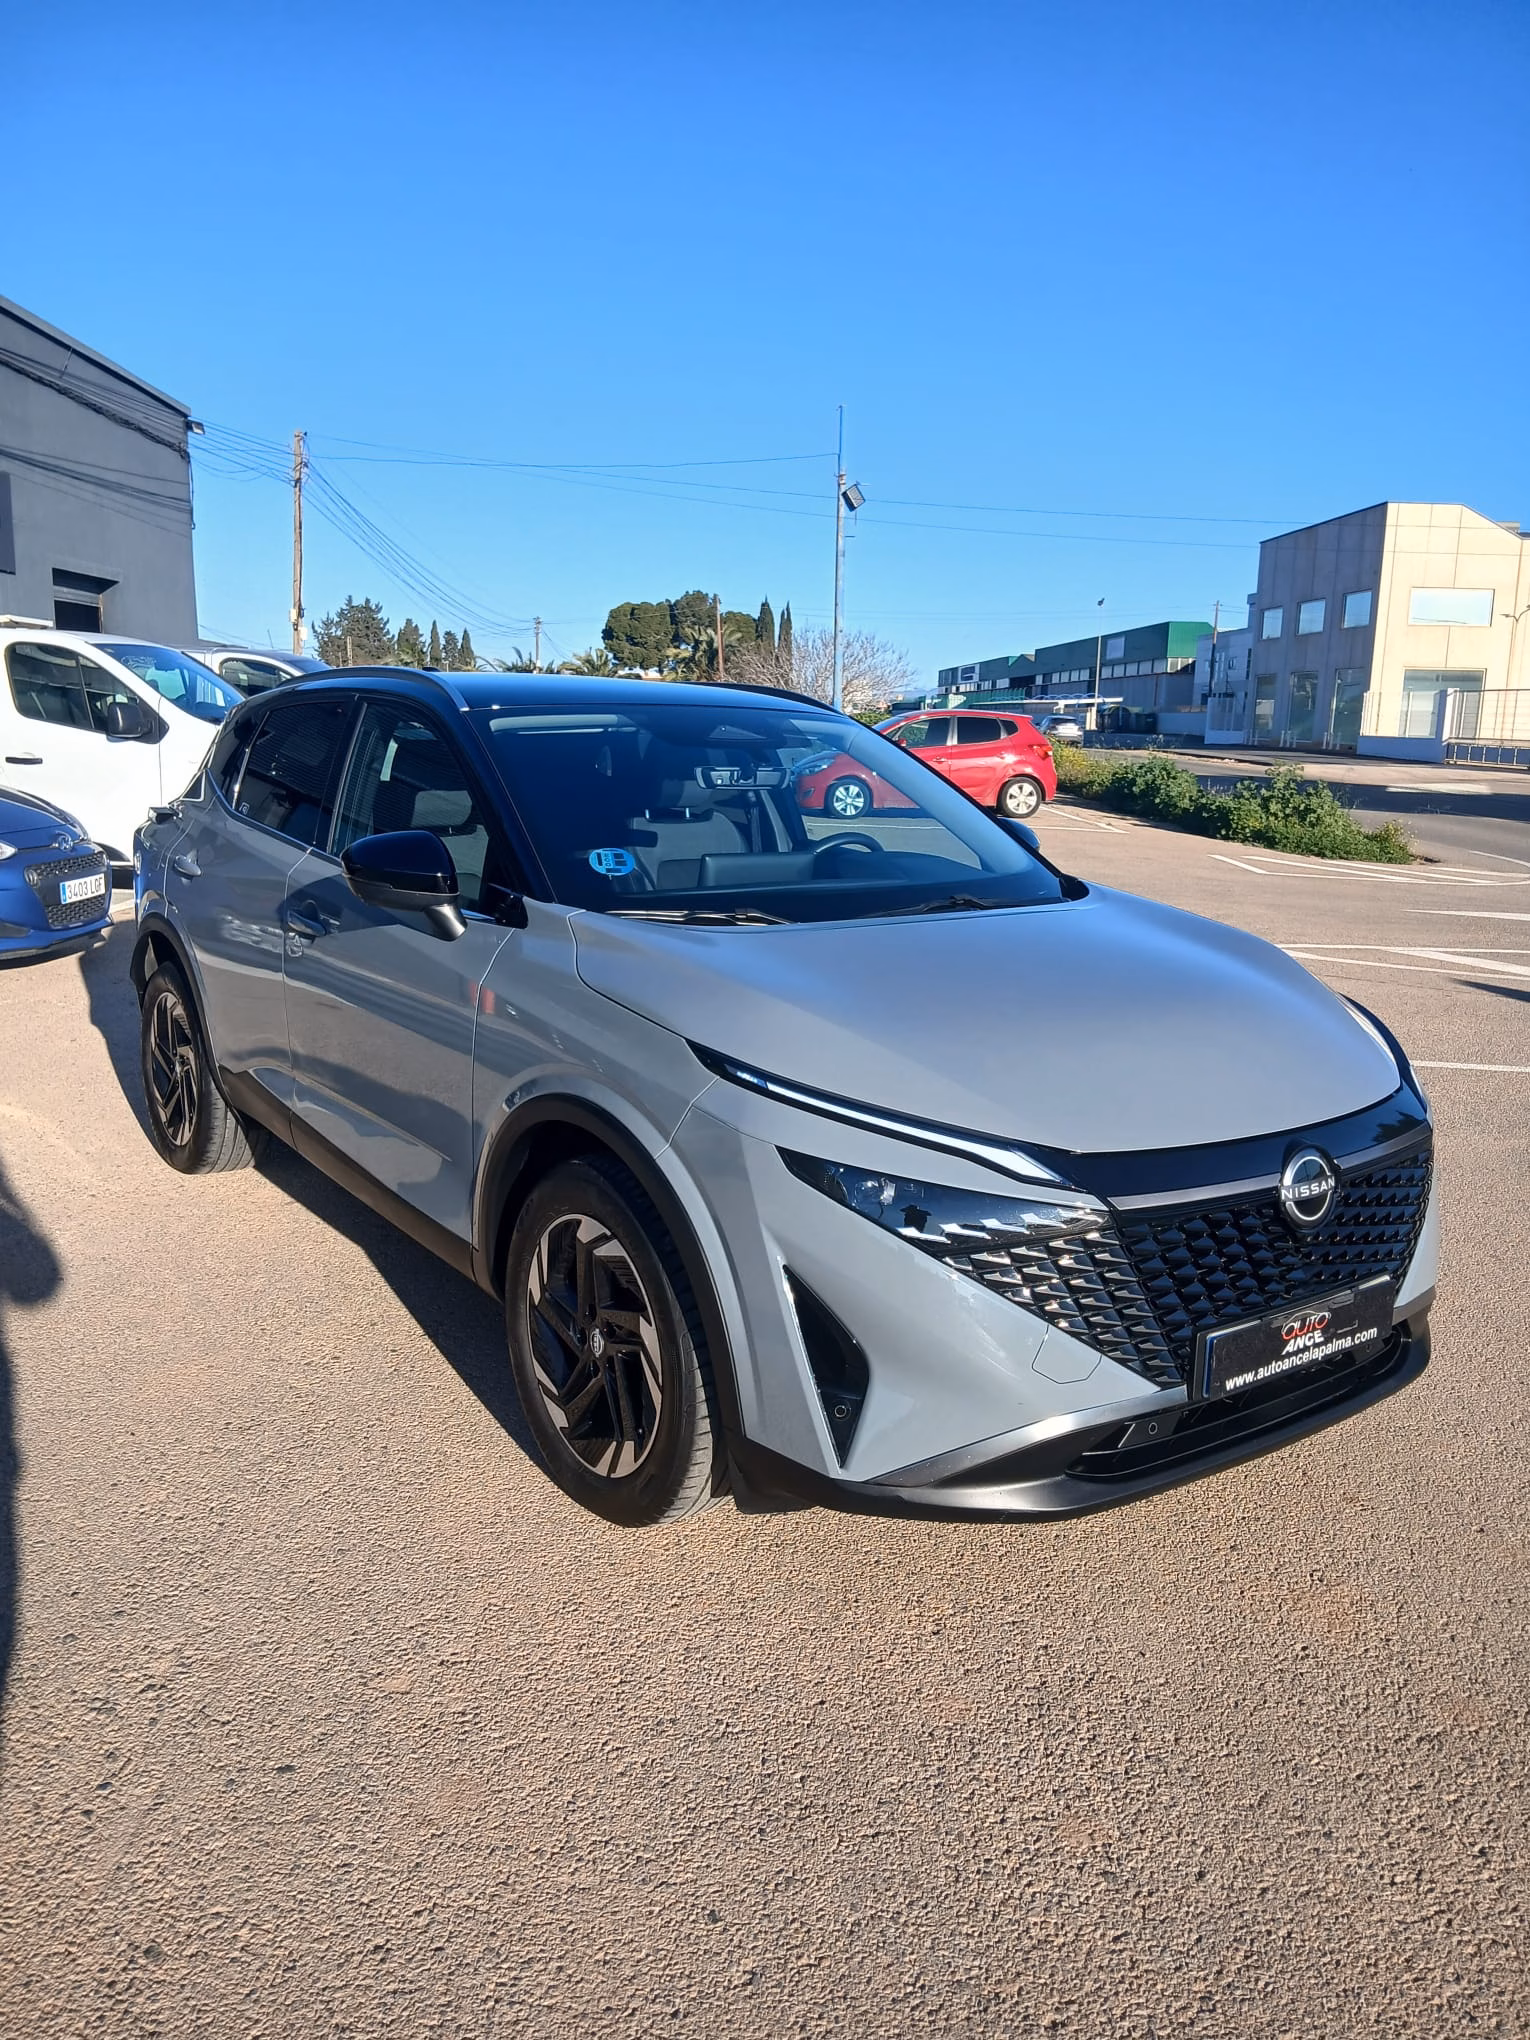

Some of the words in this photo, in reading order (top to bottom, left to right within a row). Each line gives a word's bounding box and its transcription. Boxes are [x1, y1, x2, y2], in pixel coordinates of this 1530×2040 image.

[67, 881, 89, 899] 3403
[1281, 1175, 1335, 1200] NISSAN
[1281, 1329, 1325, 1356] ANCE
[1225, 1326, 1378, 1391] www.autoancelapalma.com
